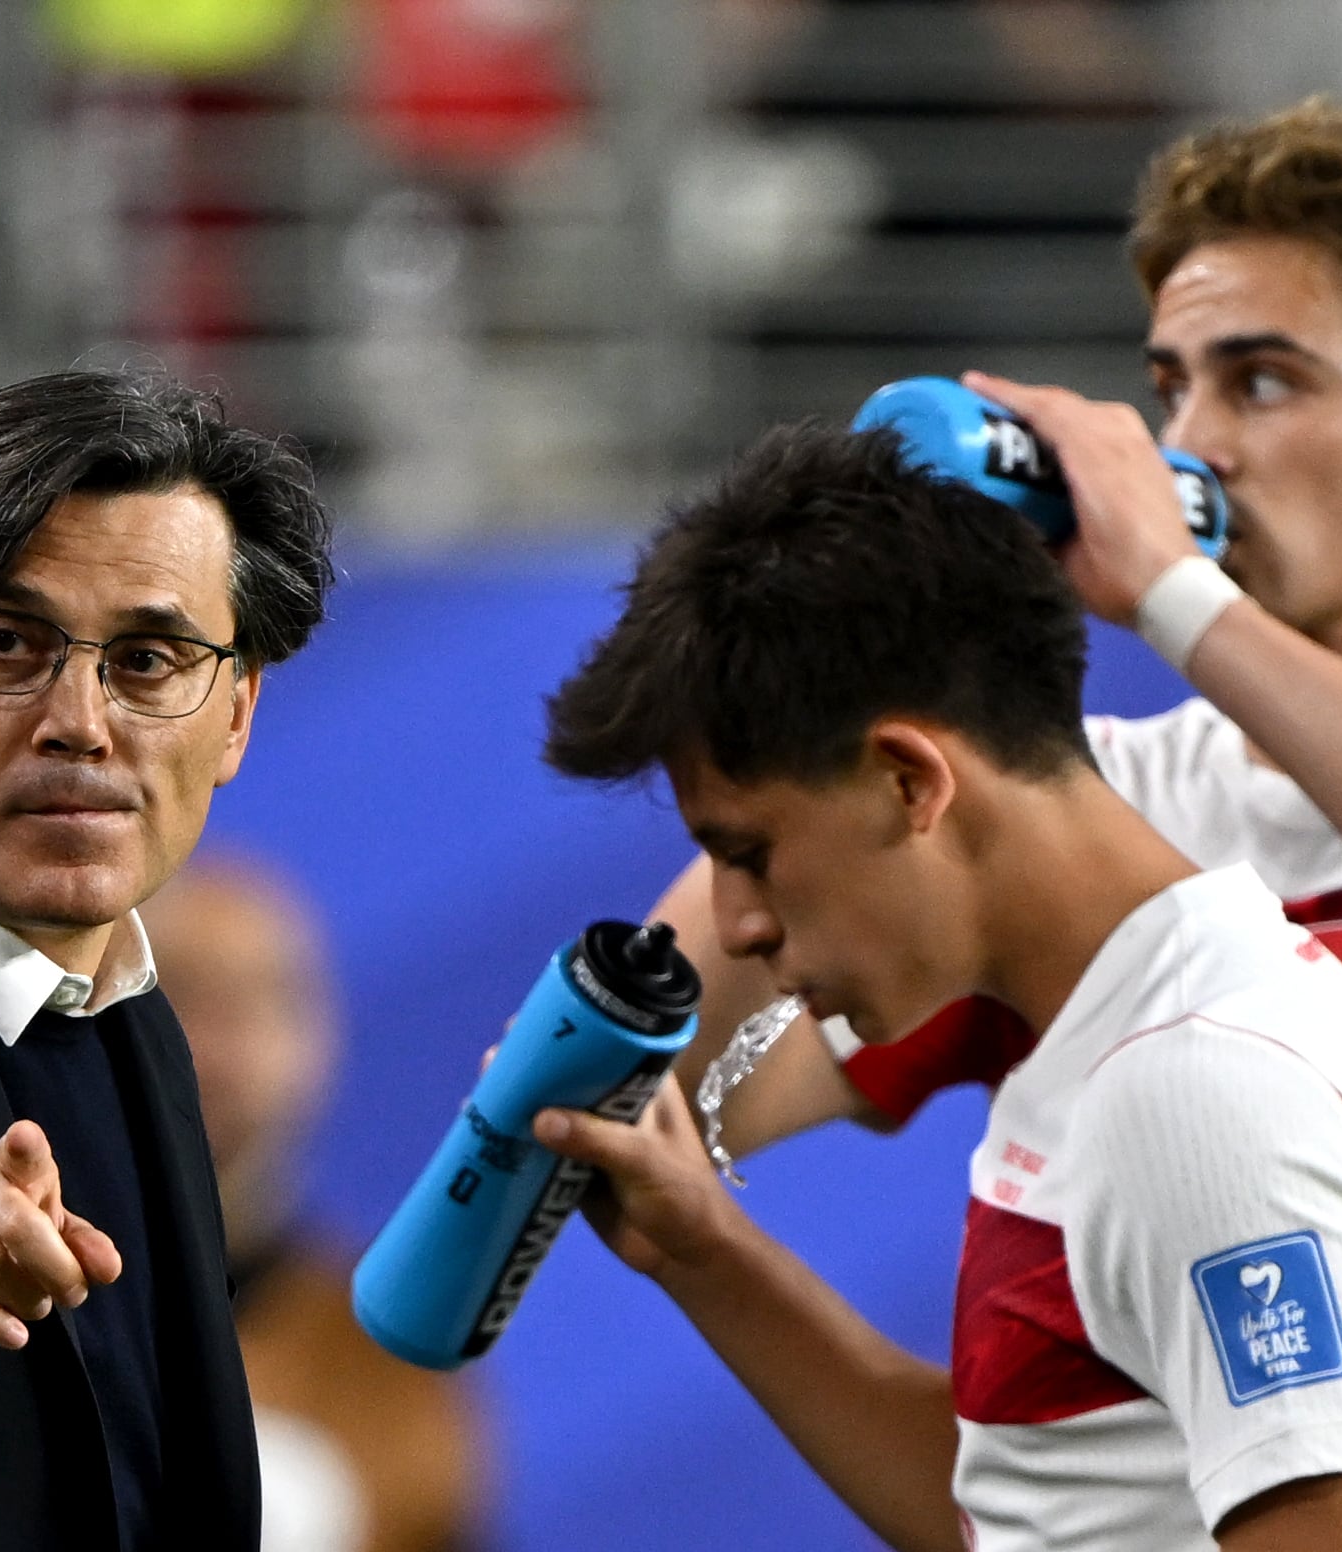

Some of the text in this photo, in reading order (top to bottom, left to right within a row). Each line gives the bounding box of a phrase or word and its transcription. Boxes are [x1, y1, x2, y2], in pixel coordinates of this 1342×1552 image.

[1277, 1298, 1307, 1329] For
[1249, 1325, 1313, 1367] PEACE
[1265, 1356, 1303, 1378] FIFA
